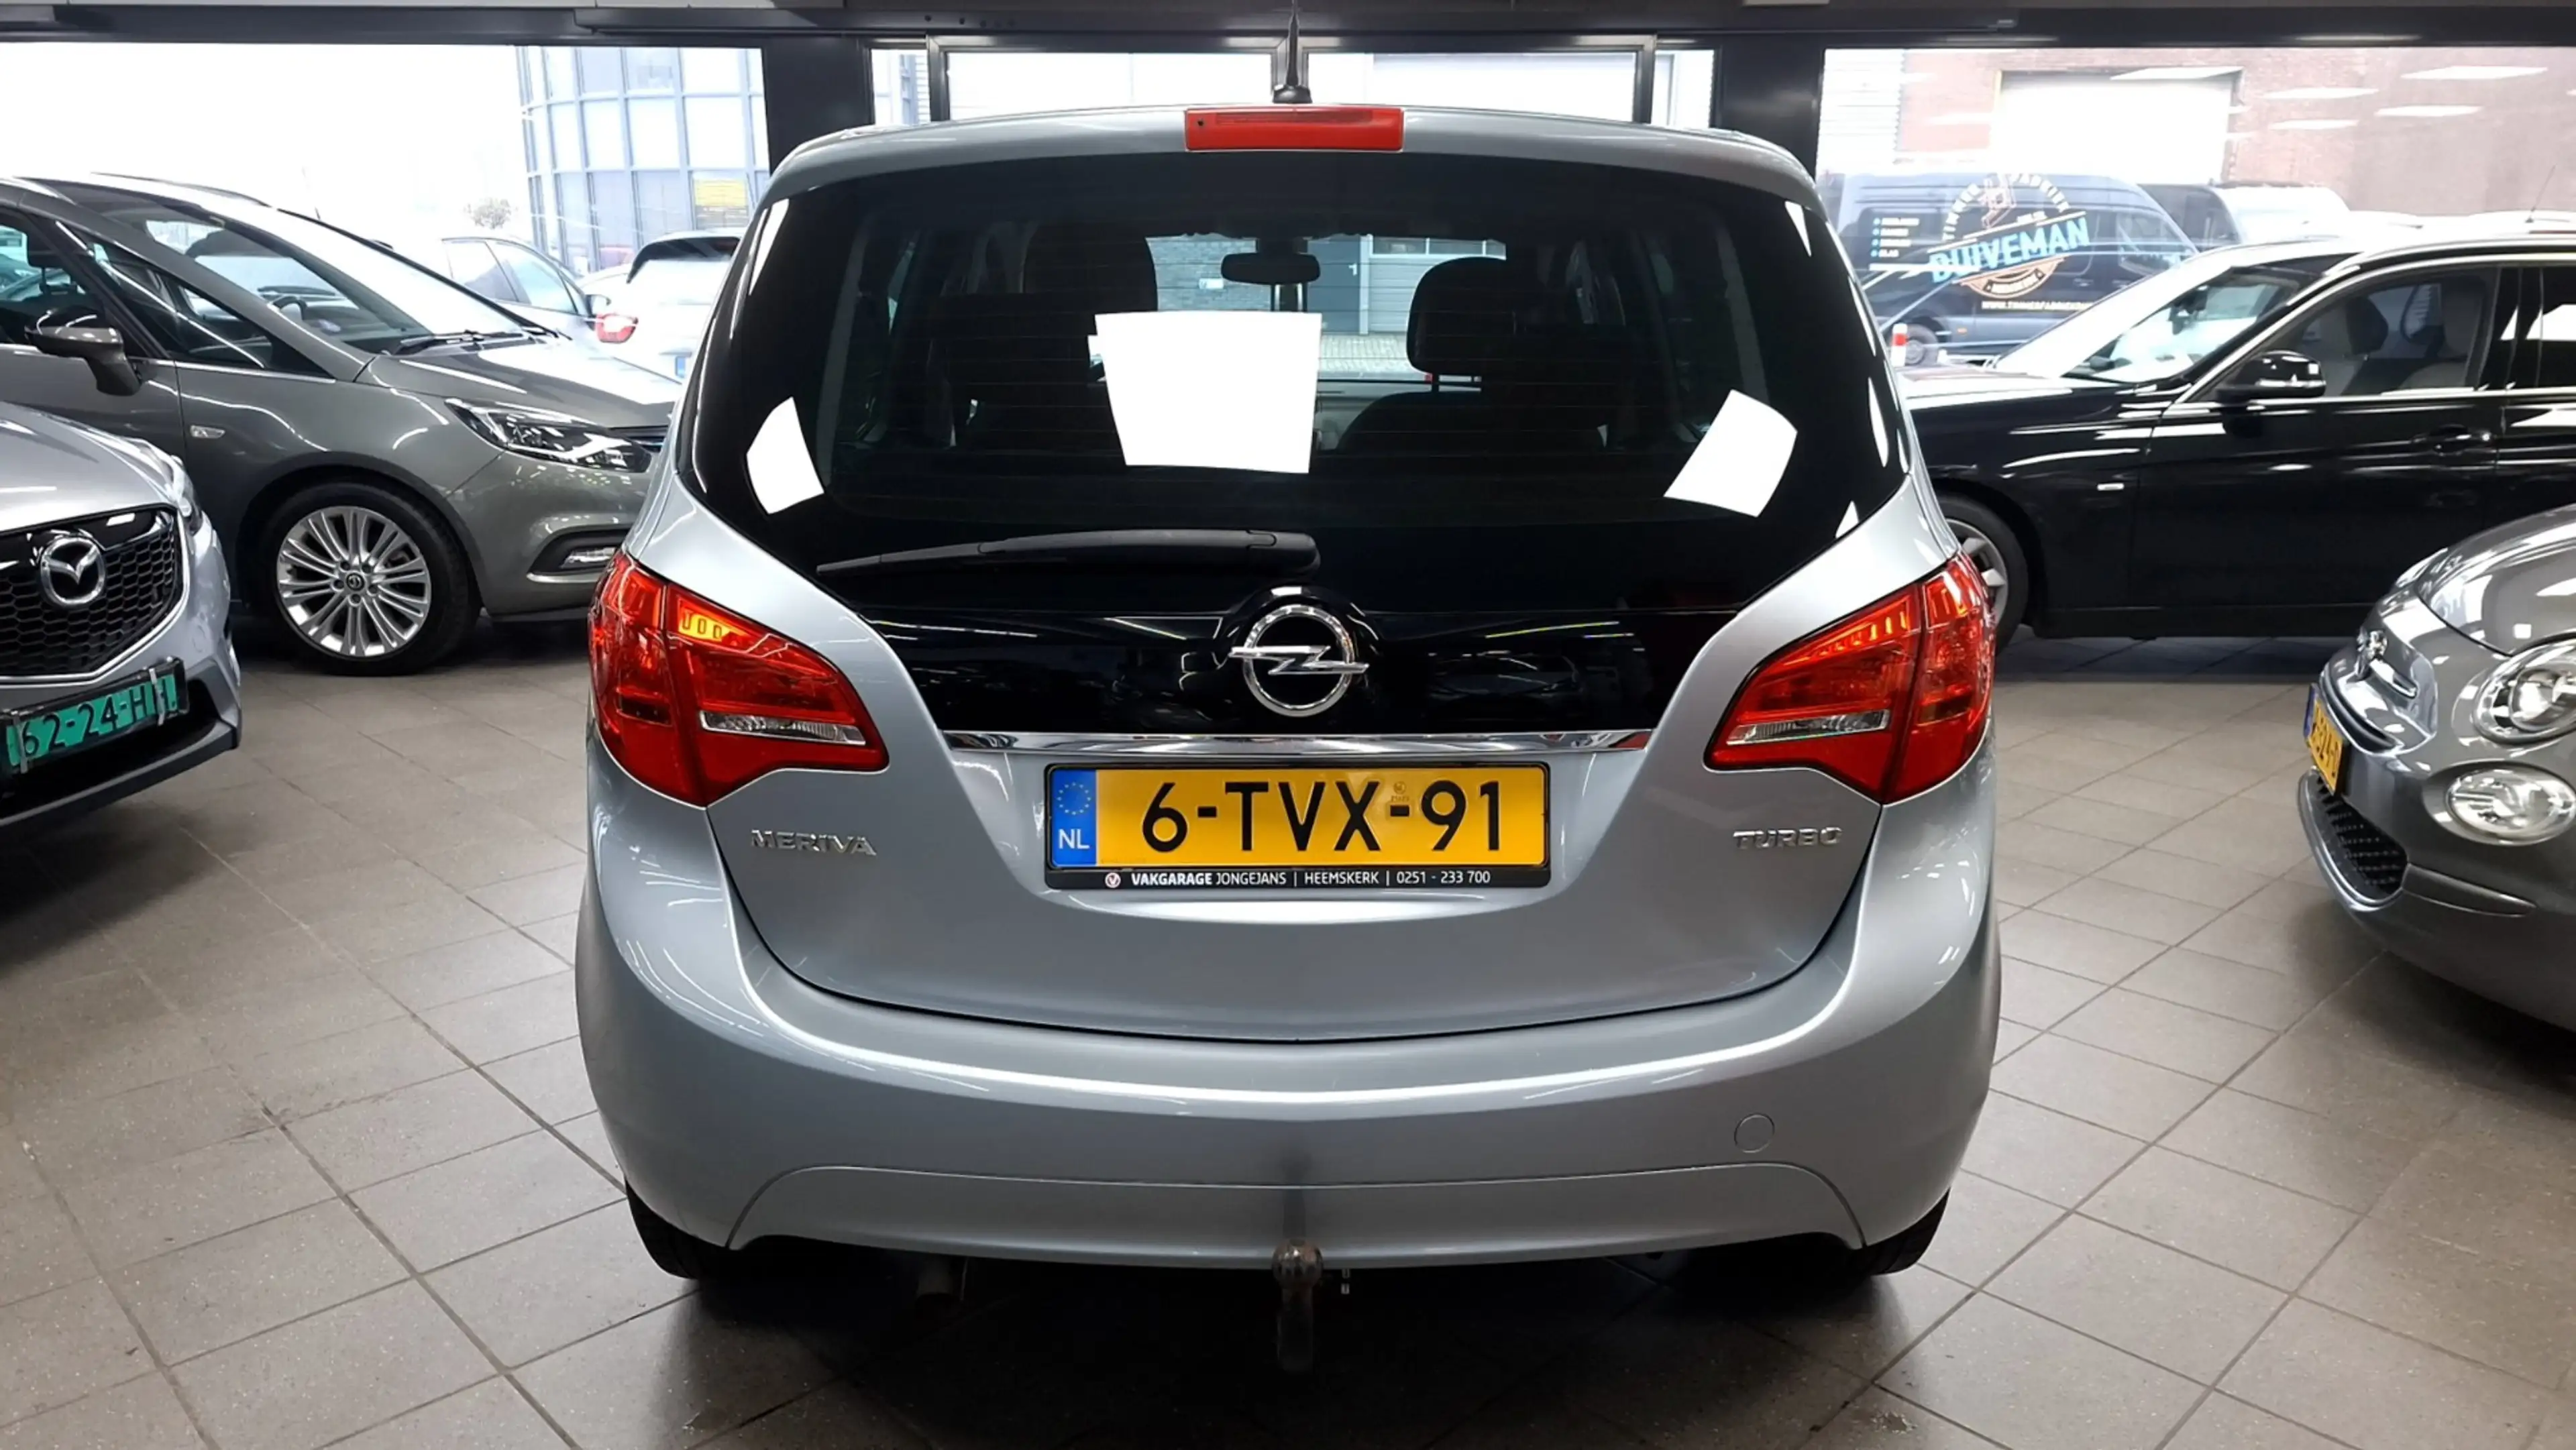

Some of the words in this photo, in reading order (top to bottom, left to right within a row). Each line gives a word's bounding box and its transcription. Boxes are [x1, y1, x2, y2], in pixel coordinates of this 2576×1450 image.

[1928, 217, 2091, 283] DUIVEMAN
[1142, 780, 1499, 852] 6-TVX-91
[751, 830, 877, 855] MERIVA
[1059, 829, 1089, 849] NL
[1733, 827, 1843, 850] TURBO
[1131, 873, 1212, 885] VAKGARAGE
[1215, 872, 1287, 885] JONGEJANS
[1305, 871, 1379, 884] HEEMSKERK
[1396, 871, 1426, 884] 0251
[1440, 871, 1464, 884] 233
[1468, 871, 1491, 883] 700
